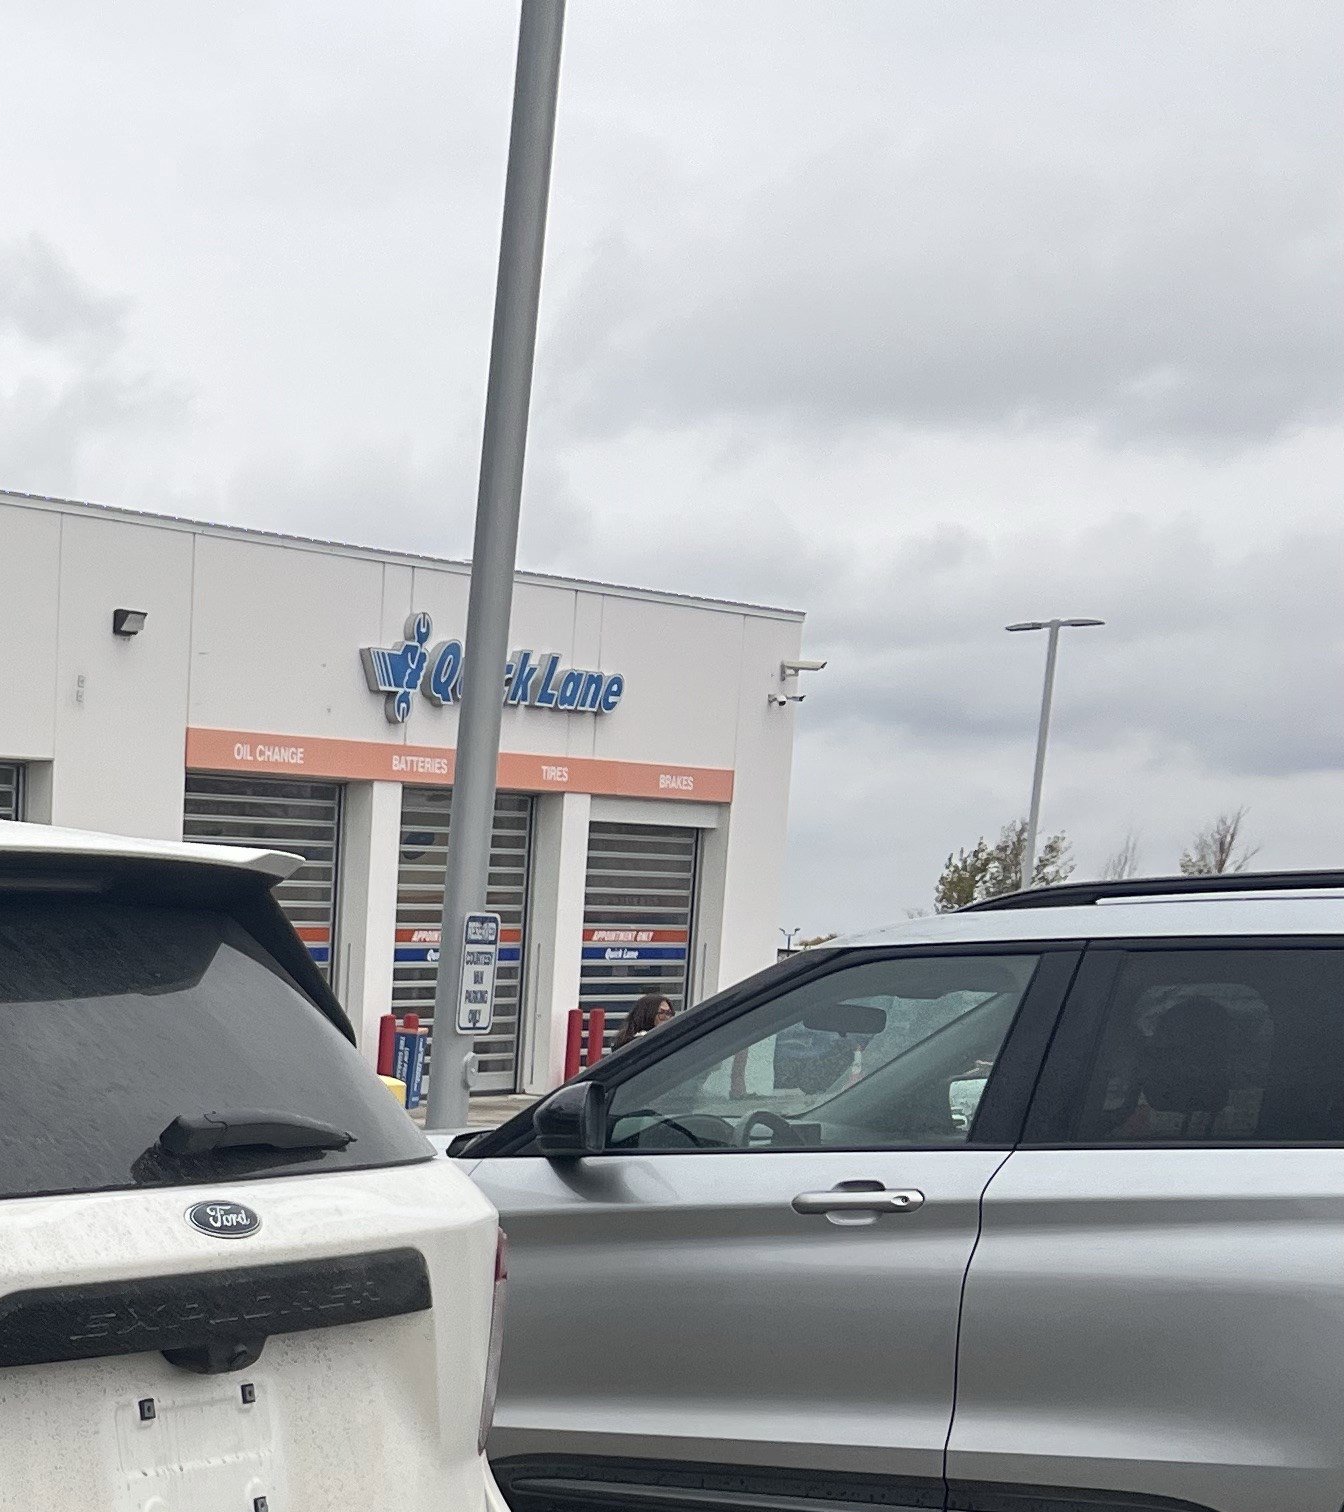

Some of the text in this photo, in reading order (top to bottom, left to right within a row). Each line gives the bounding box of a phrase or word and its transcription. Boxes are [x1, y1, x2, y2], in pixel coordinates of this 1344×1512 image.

[535, 653, 624, 713] Lane
[233, 743, 305, 764] OIL CHANGE
[392, 755, 448, 774] BATTERIES
[541, 765, 569, 782] TIRES
[659, 774, 694, 790] BRAKES
[592, 930, 637, 942] APPOINTMENT
[605, 948, 638, 961] Quick Lane
[206, 1204, 251, 1228] Ford
[69, 1279, 382, 1342] EXPLORER
